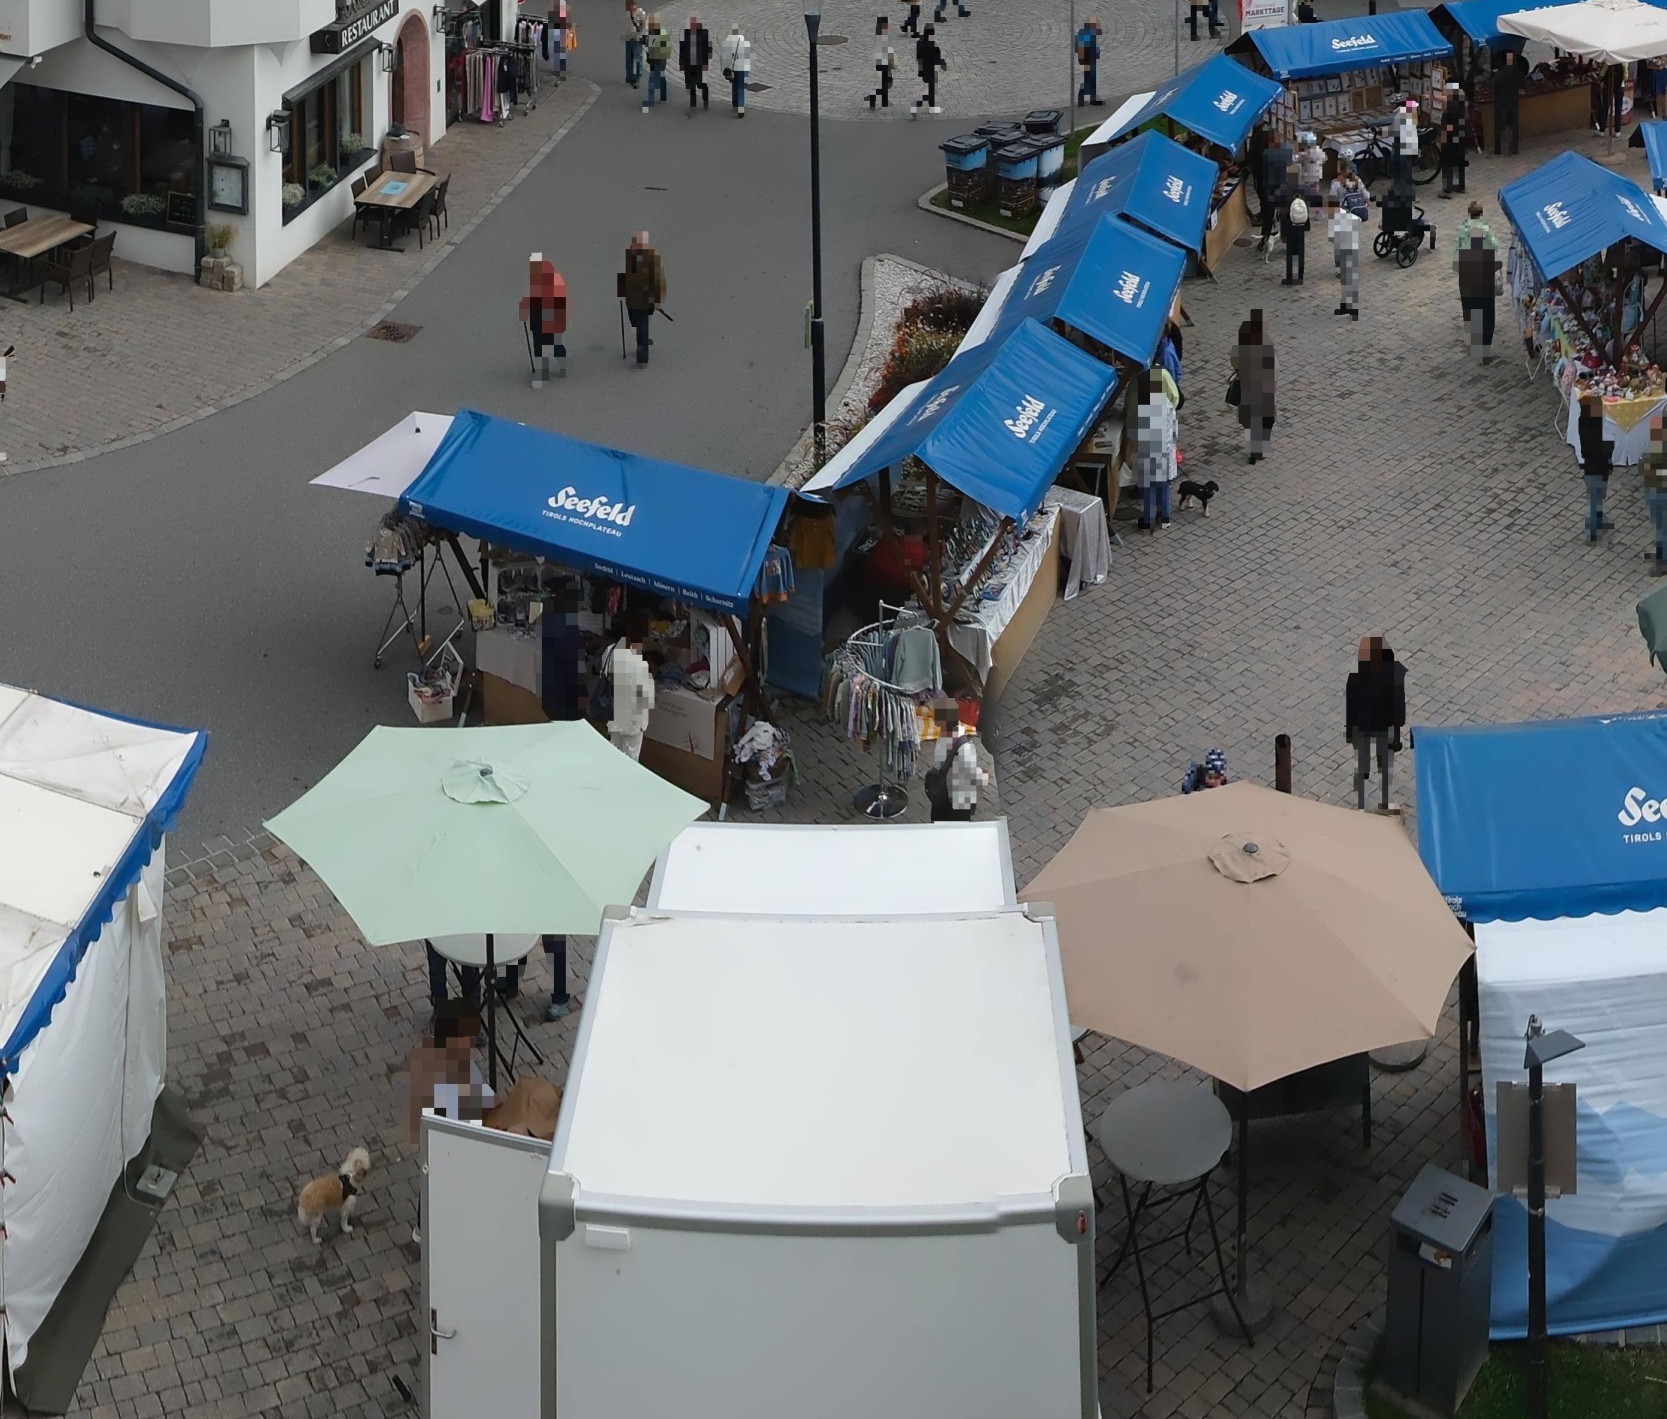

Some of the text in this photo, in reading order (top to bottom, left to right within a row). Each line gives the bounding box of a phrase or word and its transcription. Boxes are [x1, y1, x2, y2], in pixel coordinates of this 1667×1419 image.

[1245, 6, 1285, 17] MARKTTAGE
[1331, 34, 1376, 50] Seefeld
[1213, 89, 1238, 112] Seefeld
[1162, 174, 1184, 203] Seefeld
[1542, 201, 1572, 233] Seefeld
[1112, 270, 1141, 304] Seefeld
[1004, 394, 1046, 439] Seefeld
[547, 485, 637, 528] Seefeld
[541, 509, 622, 538] TIROLS HOCHPLATEAU
[1623, 830, 1662, 844] TIROLS
